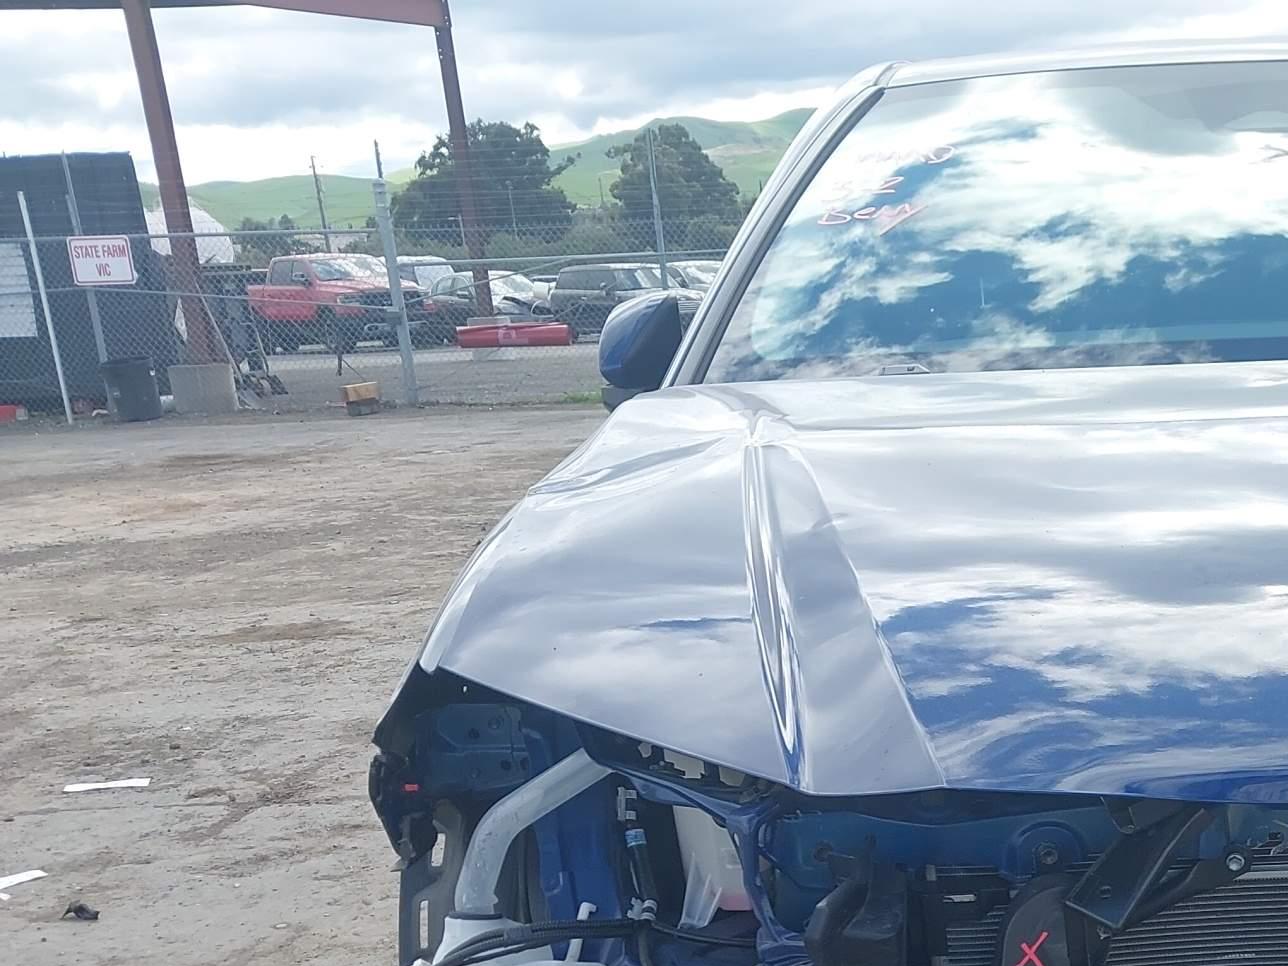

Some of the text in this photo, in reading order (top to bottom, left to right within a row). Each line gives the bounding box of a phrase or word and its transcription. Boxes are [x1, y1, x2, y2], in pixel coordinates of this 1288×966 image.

[73, 243, 127, 259] STATE FARM
[95, 262, 111, 277] VIC
